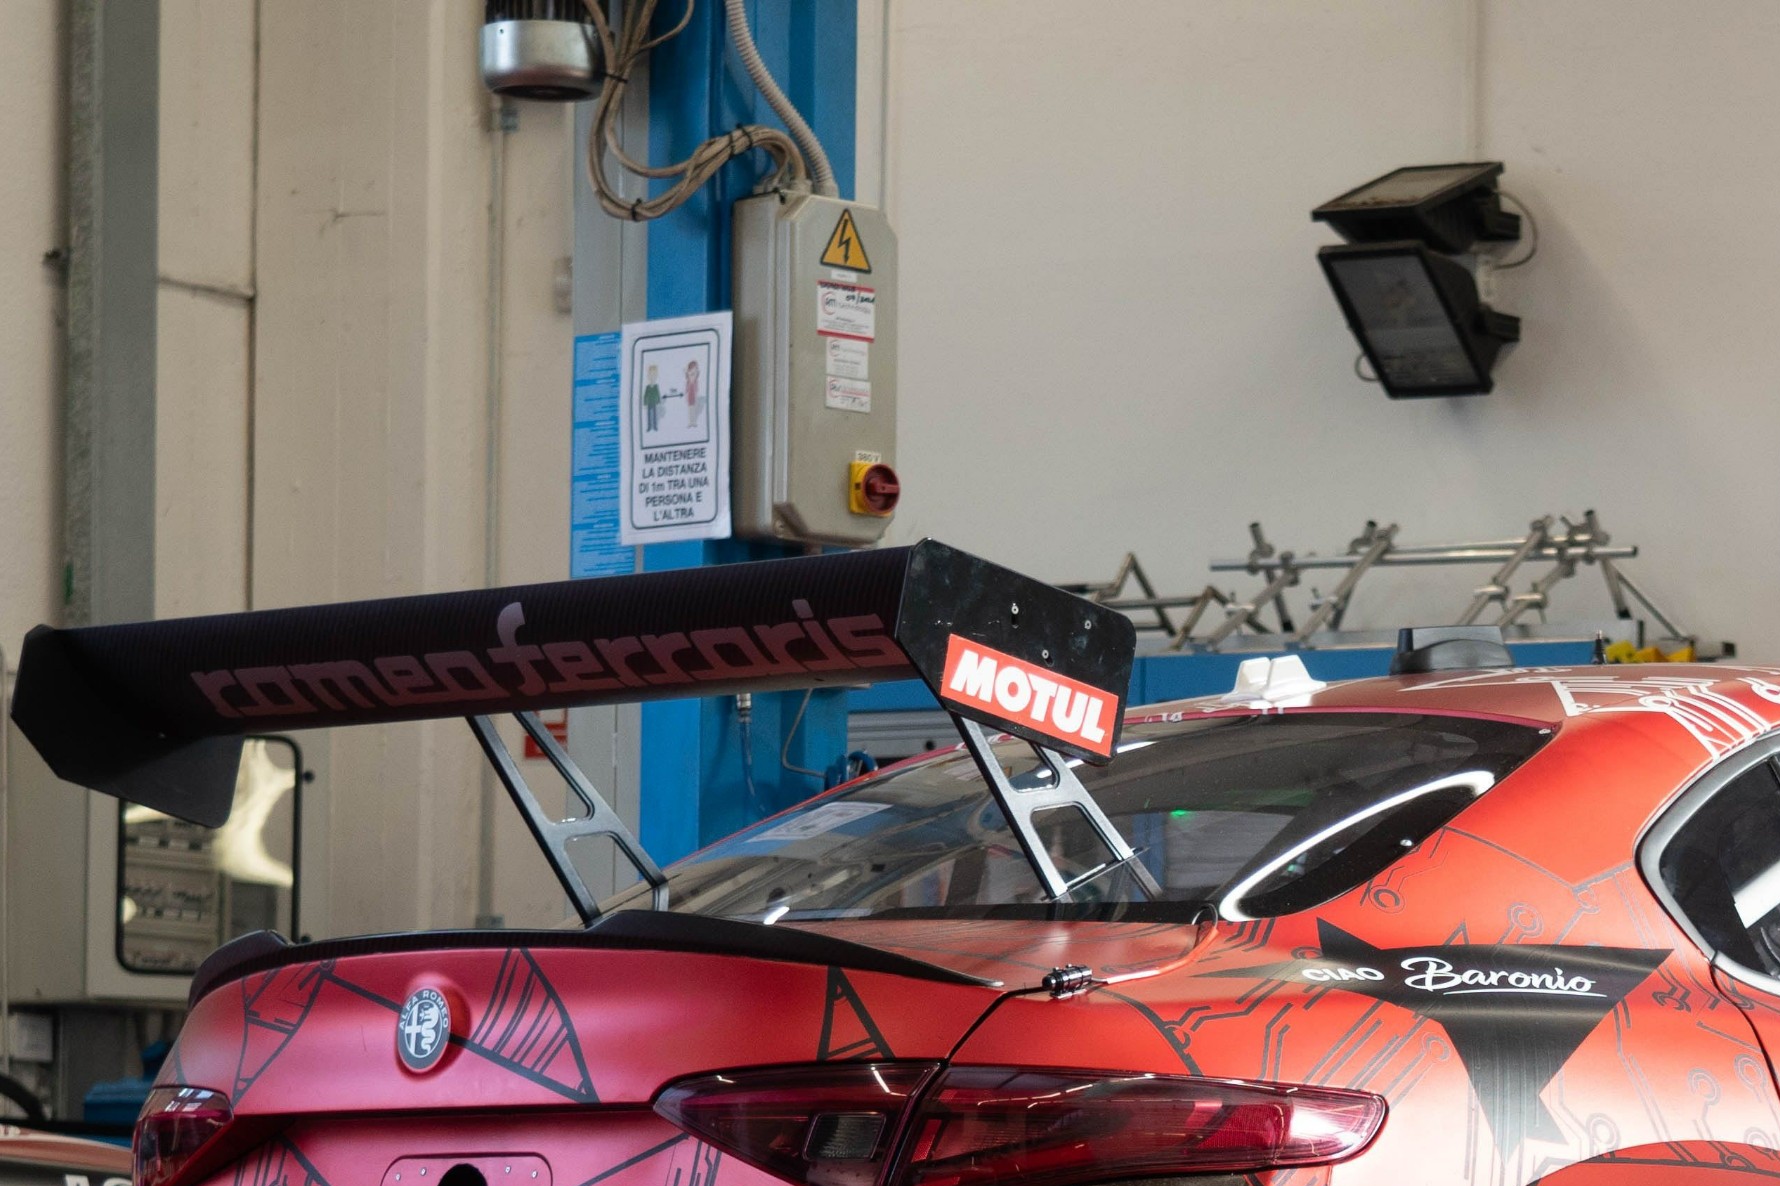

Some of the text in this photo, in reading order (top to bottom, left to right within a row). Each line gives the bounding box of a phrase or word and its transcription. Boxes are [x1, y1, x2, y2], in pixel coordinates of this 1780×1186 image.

[645, 447, 707, 464] MANTENERE
[642, 462, 708, 479] LA DISTANZA
[639, 476, 709, 494] DI 1m TRA UNA
[645, 491, 703, 508] PERSONA E
[653, 507, 695, 522] L'ALTRA
[949, 649, 1106, 744] MOTUL
[1301, 956, 1597, 992] CIAO Baronio
[399, 989, 449, 1030] ALFA ROMEO
